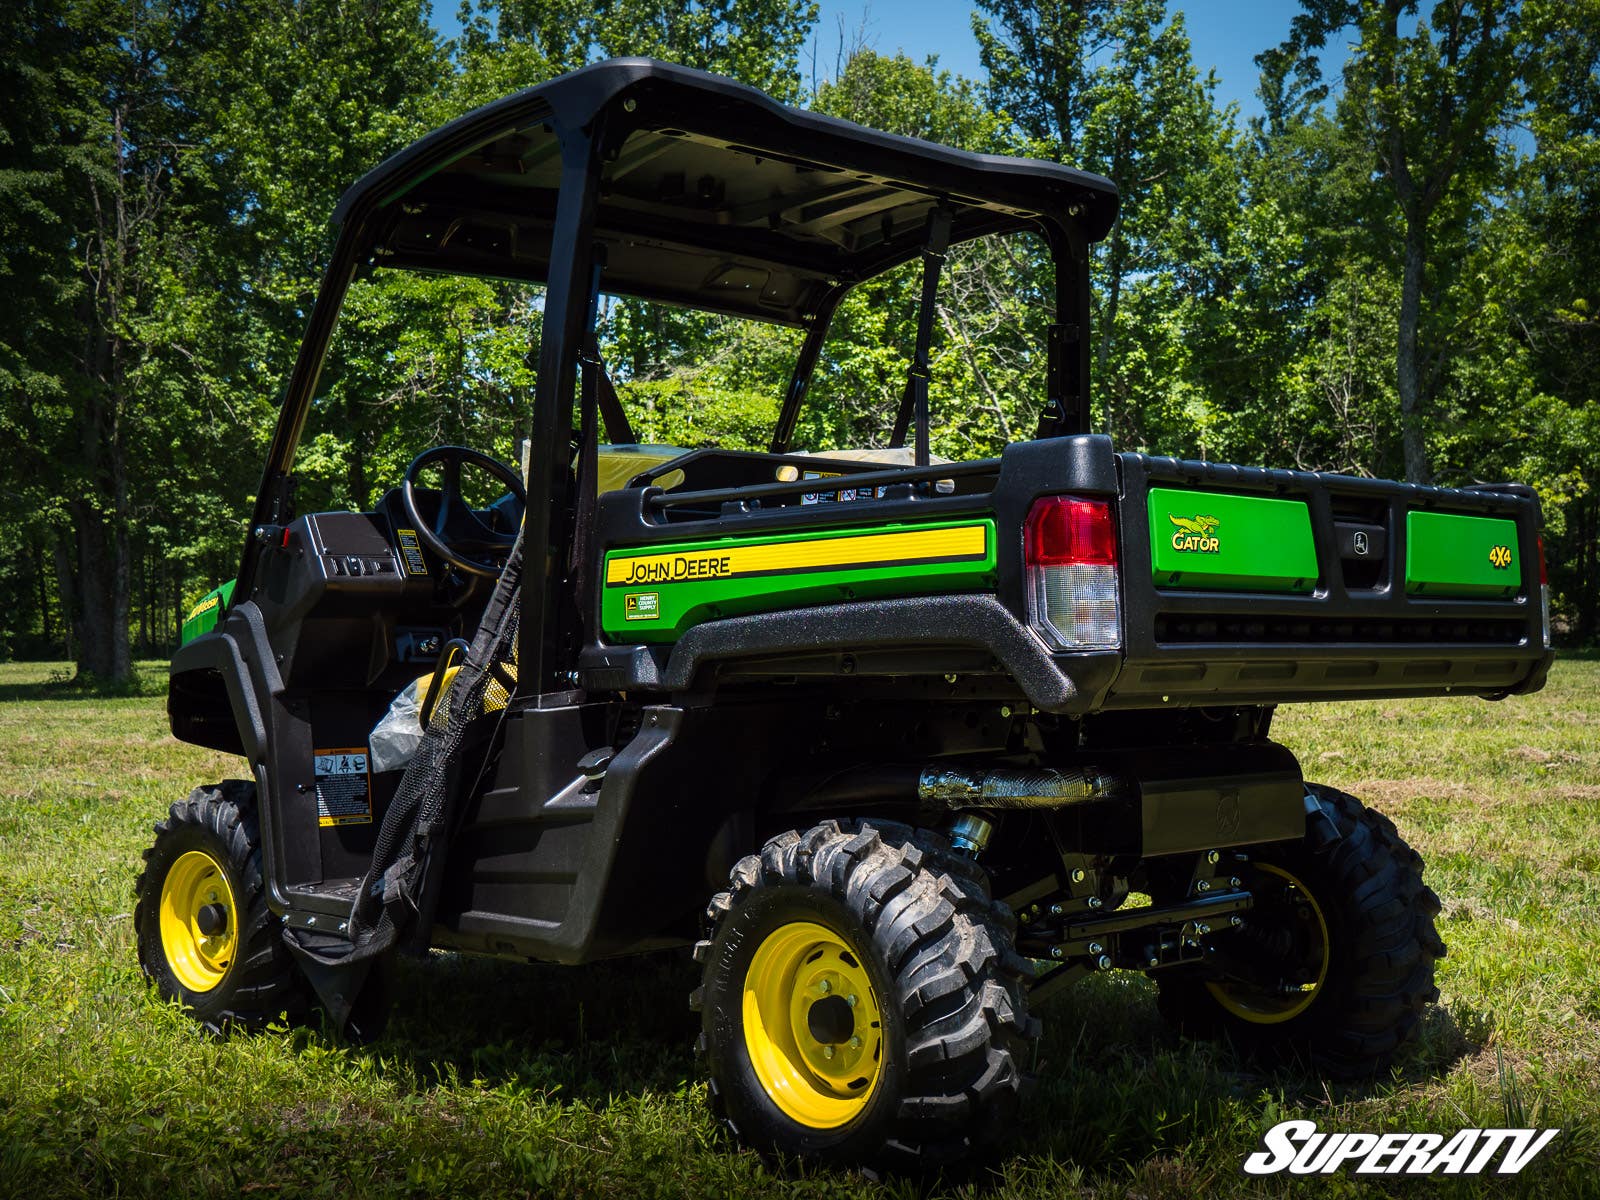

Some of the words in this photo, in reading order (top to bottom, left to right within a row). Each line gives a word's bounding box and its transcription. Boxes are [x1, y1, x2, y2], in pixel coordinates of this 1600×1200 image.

[1172, 532, 1219, 552] GATOR
[1489, 546, 1512, 567] 4X4
[626, 561, 670, 582] JOHN
[674, 557, 730, 577] DEERE
